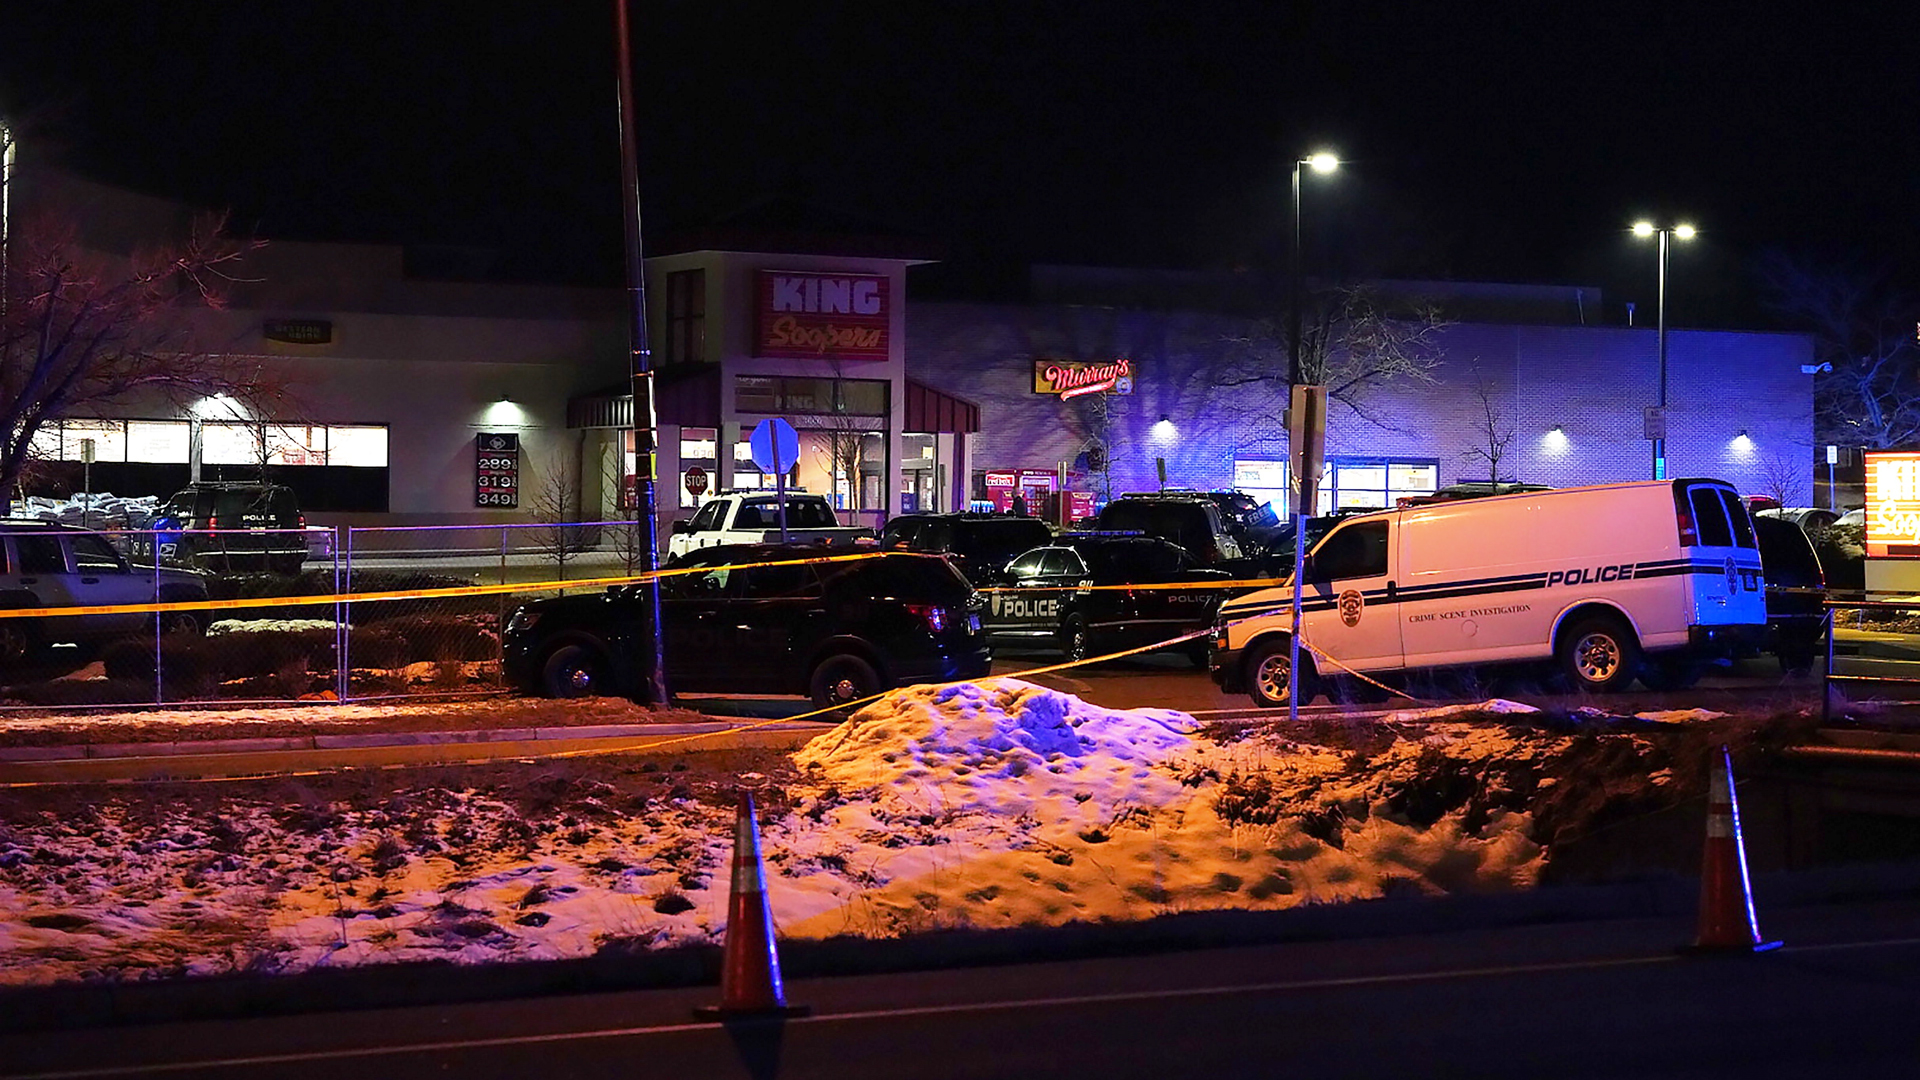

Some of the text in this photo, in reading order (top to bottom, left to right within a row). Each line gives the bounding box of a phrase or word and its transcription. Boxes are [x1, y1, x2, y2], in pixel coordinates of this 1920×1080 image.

[772, 277, 881, 315] KING
[768, 315, 882, 355] Soopers
[1045, 359, 1130, 394] Murray's
[478, 458, 511, 470] 289
[478, 476, 511, 488] 319
[686, 475, 707, 487] STOP
[1876, 460, 1920, 500] KI
[478, 493, 511, 505] 349
[1547, 563, 1635, 588] POLICE
[1004, 599, 1058, 618] POLICE
[1408, 604, 1532, 623] CRIME SCENE INVESTIGATION
